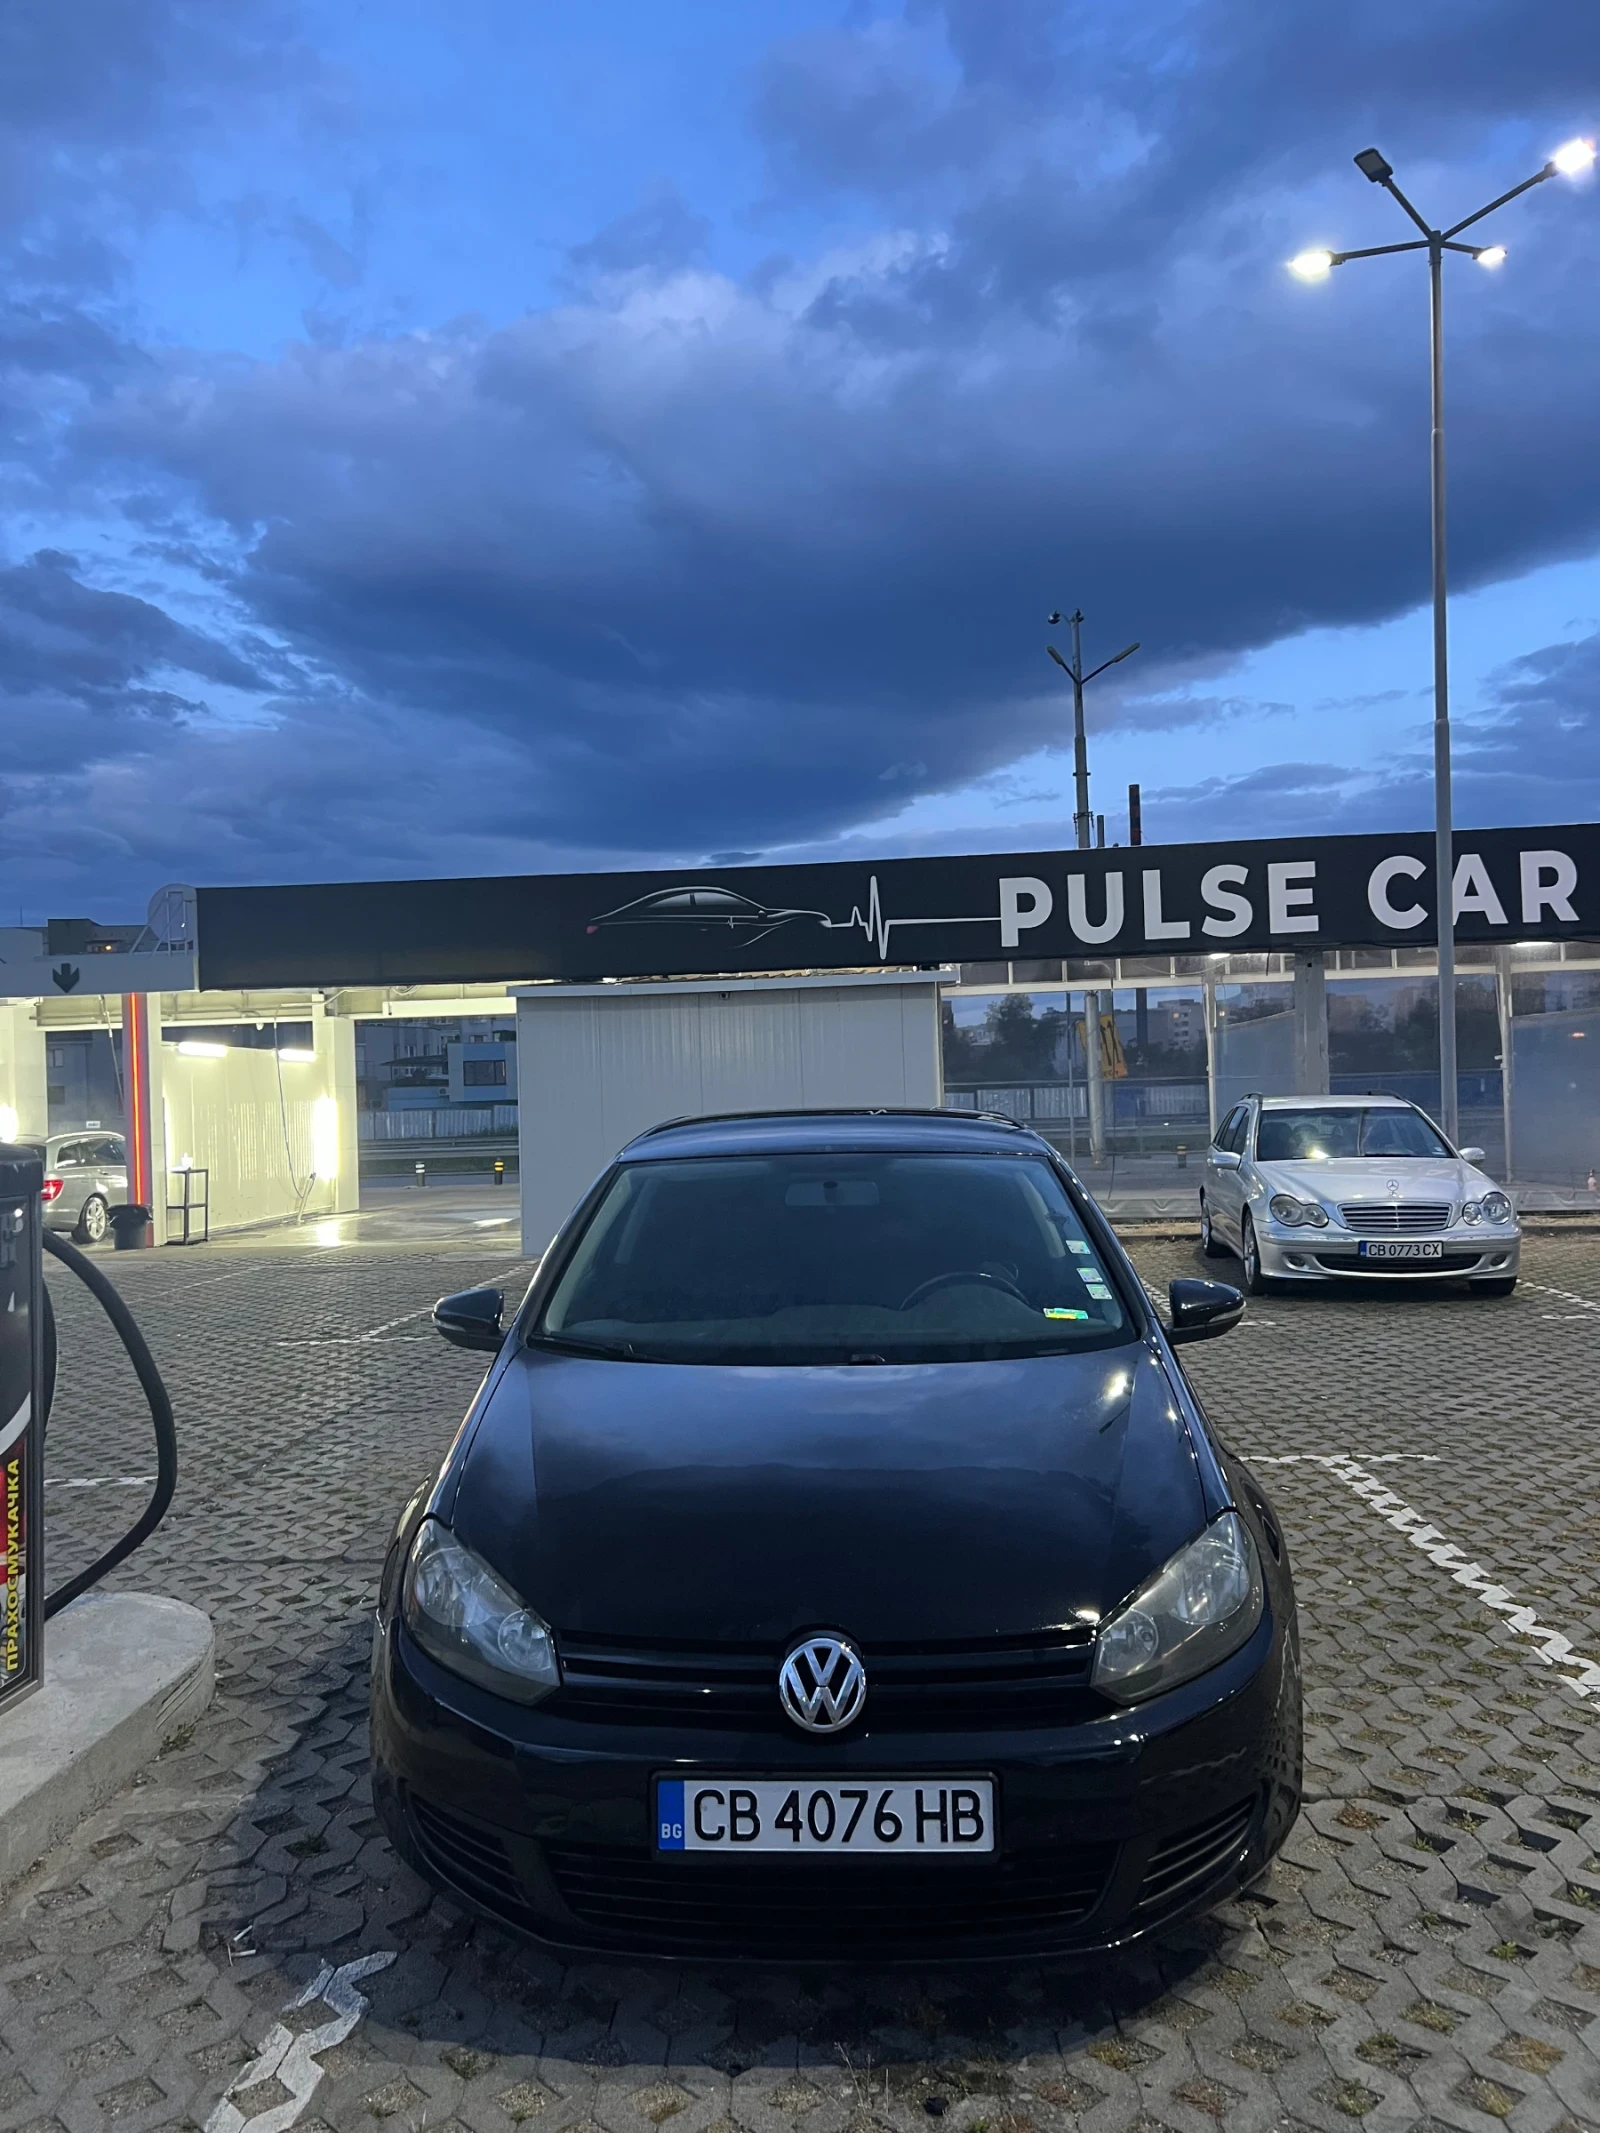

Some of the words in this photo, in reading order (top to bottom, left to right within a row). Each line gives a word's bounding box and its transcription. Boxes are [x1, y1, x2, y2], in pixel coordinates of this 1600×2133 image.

[999, 861, 1320, 948] PULSE
[1367, 850, 1580, 930] CAR
[1368, 1244, 1386, 1256] CB
[1388, 1244, 1420, 1256] 0773
[1422, 1243, 1440, 1256] CX
[6, 1458, 19, 1671] ПРАХОСМУКАЧКА
[660, 1823, 683, 1840] BG
[693, 1789, 761, 1842] CB
[774, 1789, 903, 1843] 4076
[915, 1788, 985, 1843] HB
